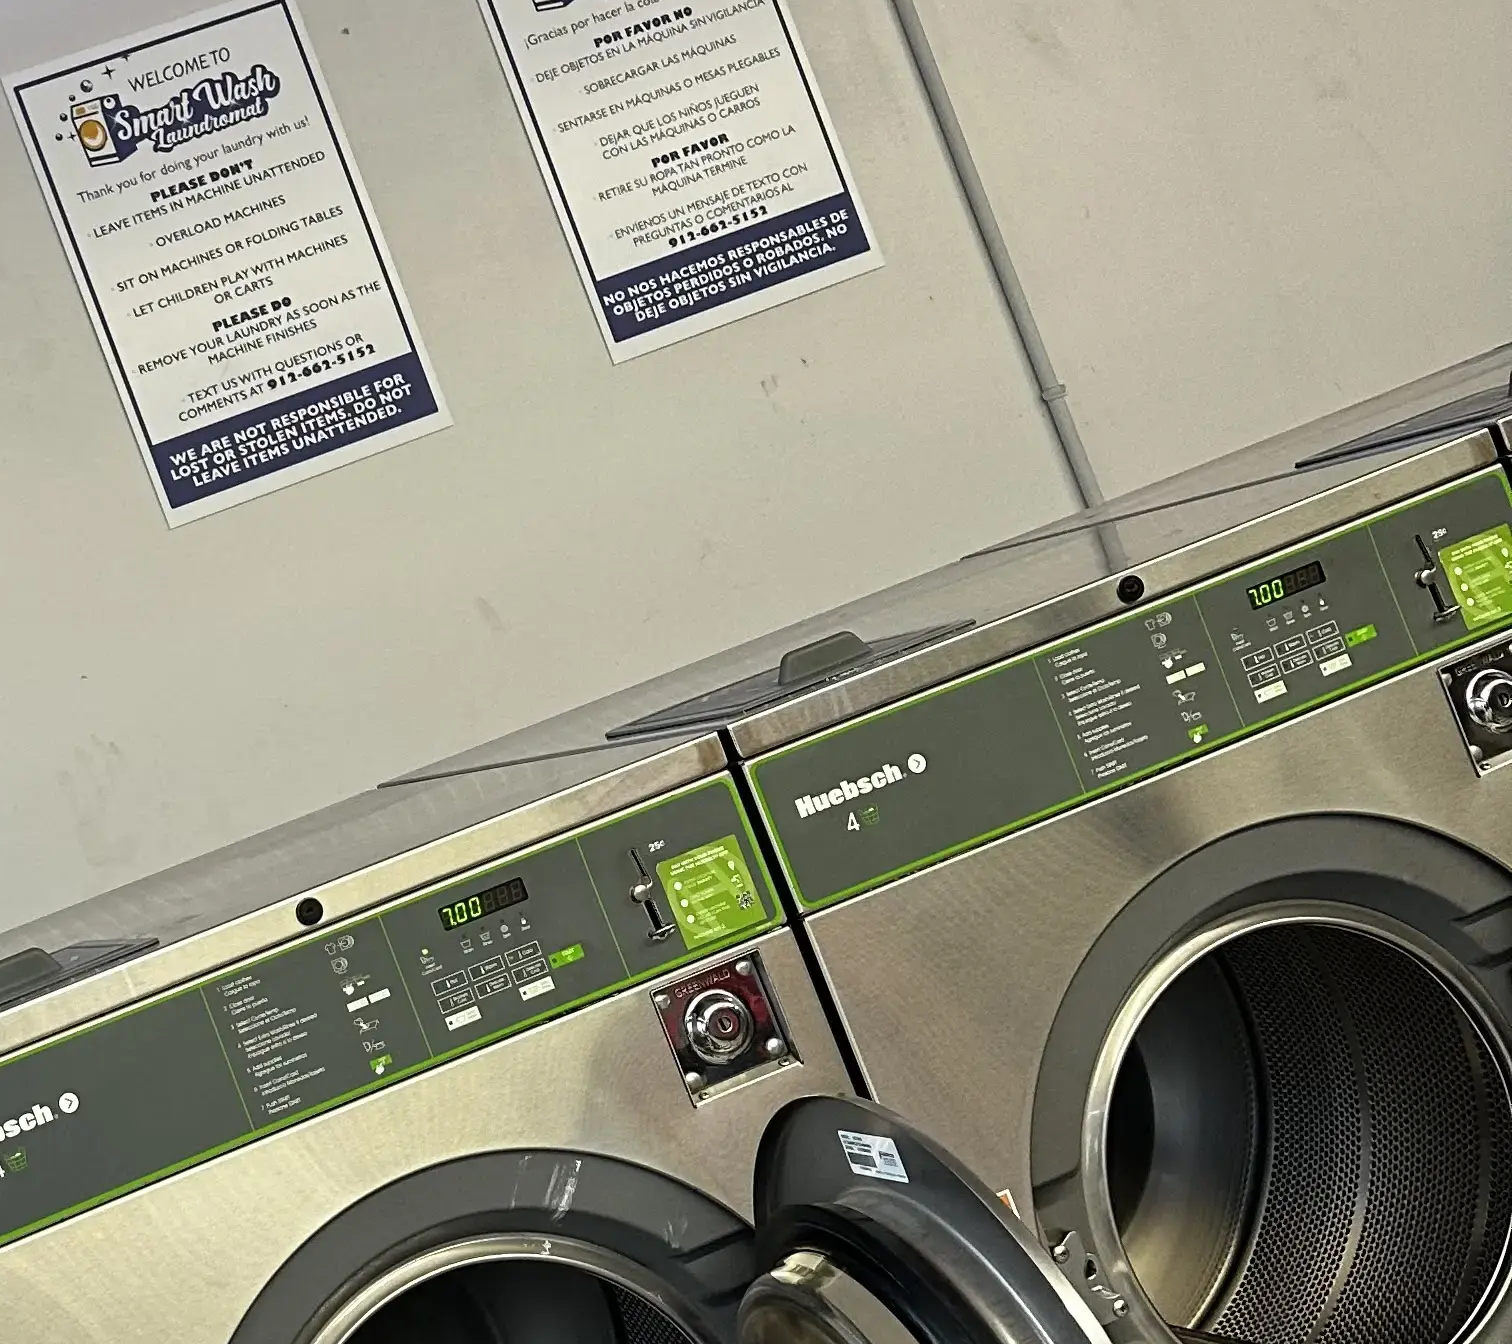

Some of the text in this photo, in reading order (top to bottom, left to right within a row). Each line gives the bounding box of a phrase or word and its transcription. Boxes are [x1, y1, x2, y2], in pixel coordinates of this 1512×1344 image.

[525, 25, 569, 50] ¡Gracias
[570, 18, 590, 35] por
[591, 6, 622, 24] hacer
[623, 1, 636, 13] la
[535, 67, 560, 83] DEJE
[560, 51, 605, 74] OBJETOS
[605, 46, 622, 59] EN
[621, 41, 637, 53] LA
[636, 23, 689, 47] MÁQUINA
[689, 15, 707, 30] SIN
[593, 6, 693, 49] POR FAVOR NO
[127, 46, 231, 92] WELCOME TO
[557, 46, 781, 133] SENTARSE EN MÁQUINAS O MESAS PLEGABLES
[583, 33, 737, 95] SOBRECARGAR LAS MÁQUINAS
[117, 64, 276, 140] Smart Wash
[155, 99, 265, 148] Laundromat
[598, 83, 760, 147] DEJAR QUE LOS NIÑOS JUEGUEN
[76, 115, 309, 204] Thank you for doing your laundry with us!
[149, 158, 253, 203] PLEASE DON'T
[598, 124, 797, 202] RETIRE SU ROPA TAN PRONTO COMO LA
[650, 133, 730, 169] POR FAVOR
[651, 155, 748, 197] MÁQUINA TERMINE
[92, 150, 326, 239] LEAVE ITEMS IN MACHINE UNATTENDED
[155, 194, 286, 247] OVERLOAD MACHINES
[668, 205, 768, 248] 912-662-5152
[116, 205, 344, 293] SIT ON MACHINES OR FOLDING TABLES
[132, 234, 349, 318] LET CHILDREN PLAY WITH MACHINES
[602, 208, 849, 307] NO NOS HACEMOS RESPONSABLES DE
[613, 223, 848, 316] OBJETOS PERDIDOS O ROBADOS. NO
[213, 275, 274, 304] OR CARTS
[634, 242, 836, 322] DEJE OBJETOS SIN VIGILANCIA.
[137, 280, 381, 375] REMOVE YOUR LAUNDRY AS SOON AS THE
[207, 318, 318, 365] MACHINE FINISHES
[211, 296, 292, 333] PLEASE DO
[178, 343, 376, 422] COMMENTS AT 912-662-5152
[187, 333, 364, 403] TEXT US WITH QUESTIONS OR
[169, 373, 406, 466] WE ARE NOT RESPONSIBLE FOR
[170, 383, 412, 481] LOST OR STOLEN ITEMS. DO NOT
[192, 404, 402, 487] LEAVE ITEMS UNATTENDED.
[794, 763, 903, 819] Huebsch
[847, 812, 861, 831] 4
[442, 896, 482, 926] 7.00
[674, 969, 732, 999] GREENWALD
